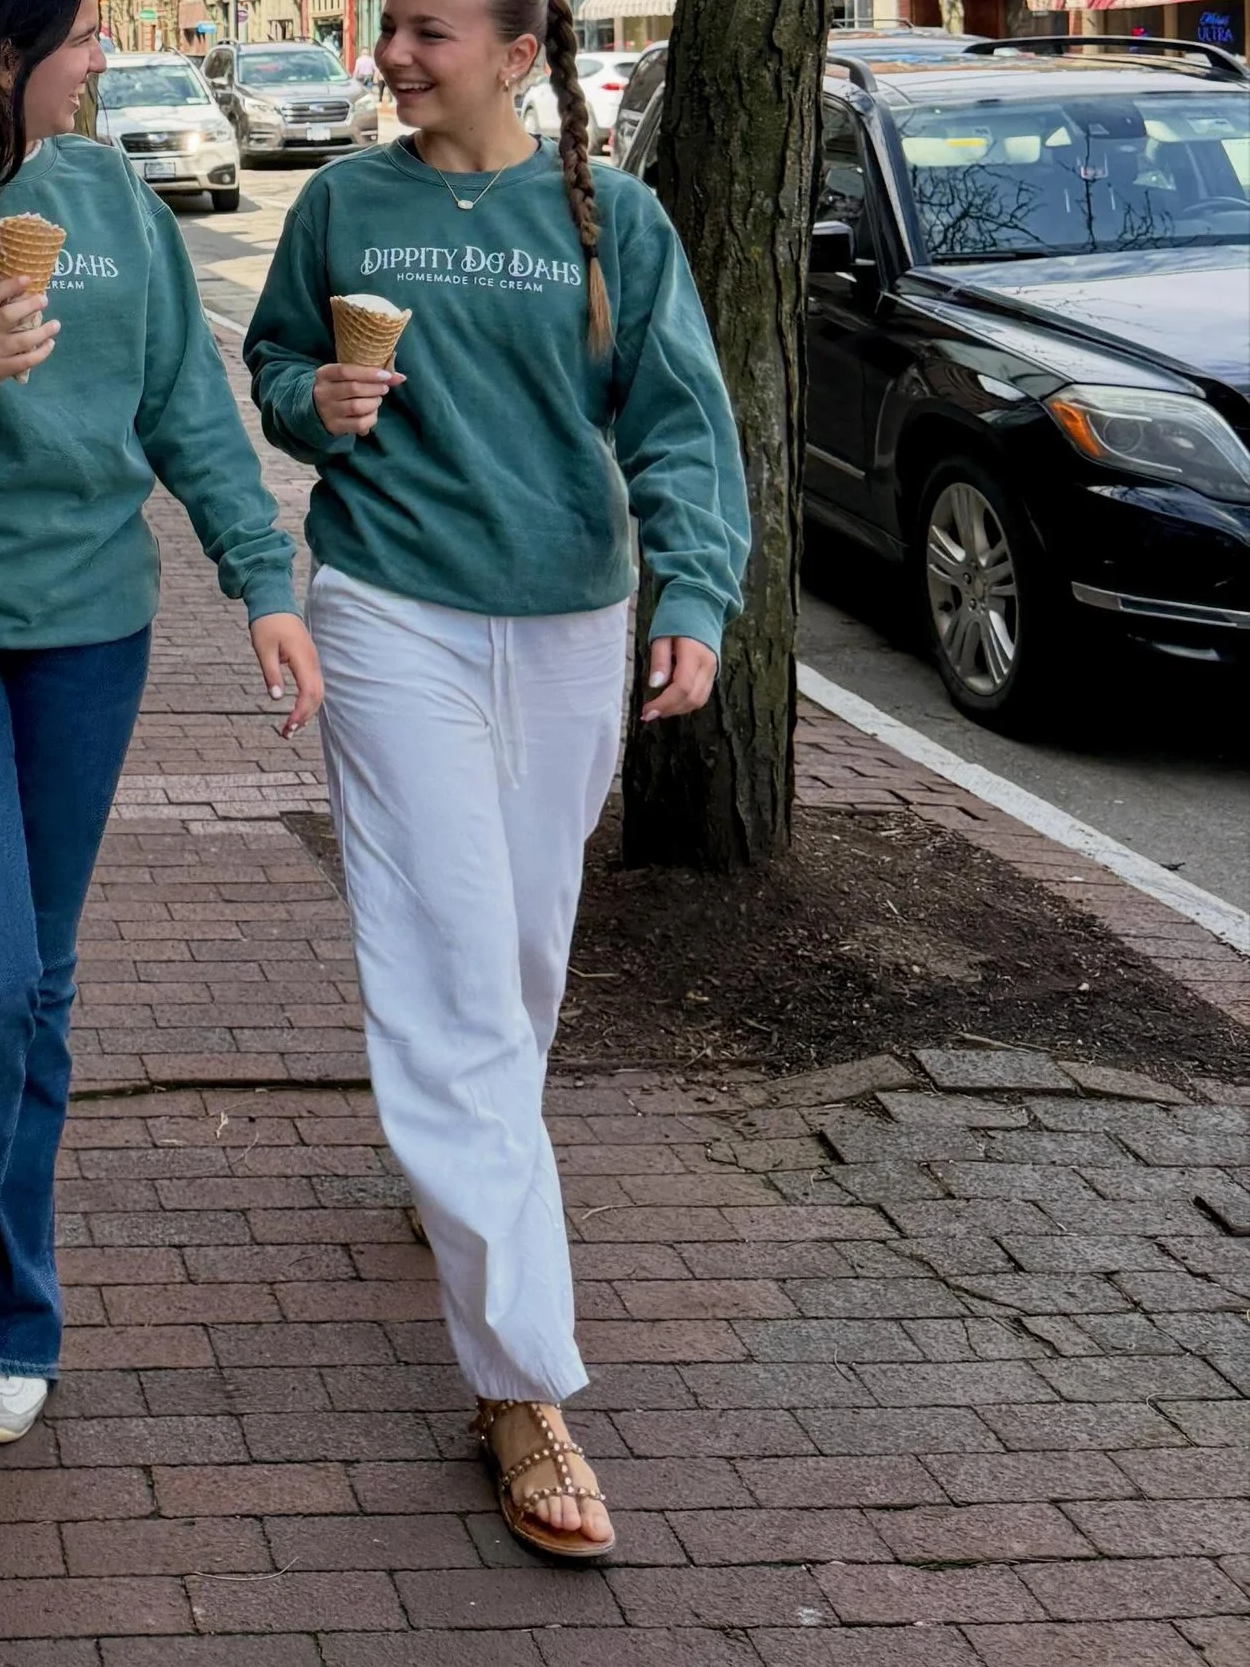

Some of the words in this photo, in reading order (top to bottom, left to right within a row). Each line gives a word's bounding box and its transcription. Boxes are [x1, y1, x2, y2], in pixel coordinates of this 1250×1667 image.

[1197, 26, 1233, 43] ULTRA
[360, 247, 458, 275] DIPPITY
[461, 245, 505, 274] DO
[508, 248, 582, 285] DAHS
[396, 272, 468, 285] HOMEMADE
[474, 277, 494, 287] ICE
[499, 280, 543, 292] CREAM
